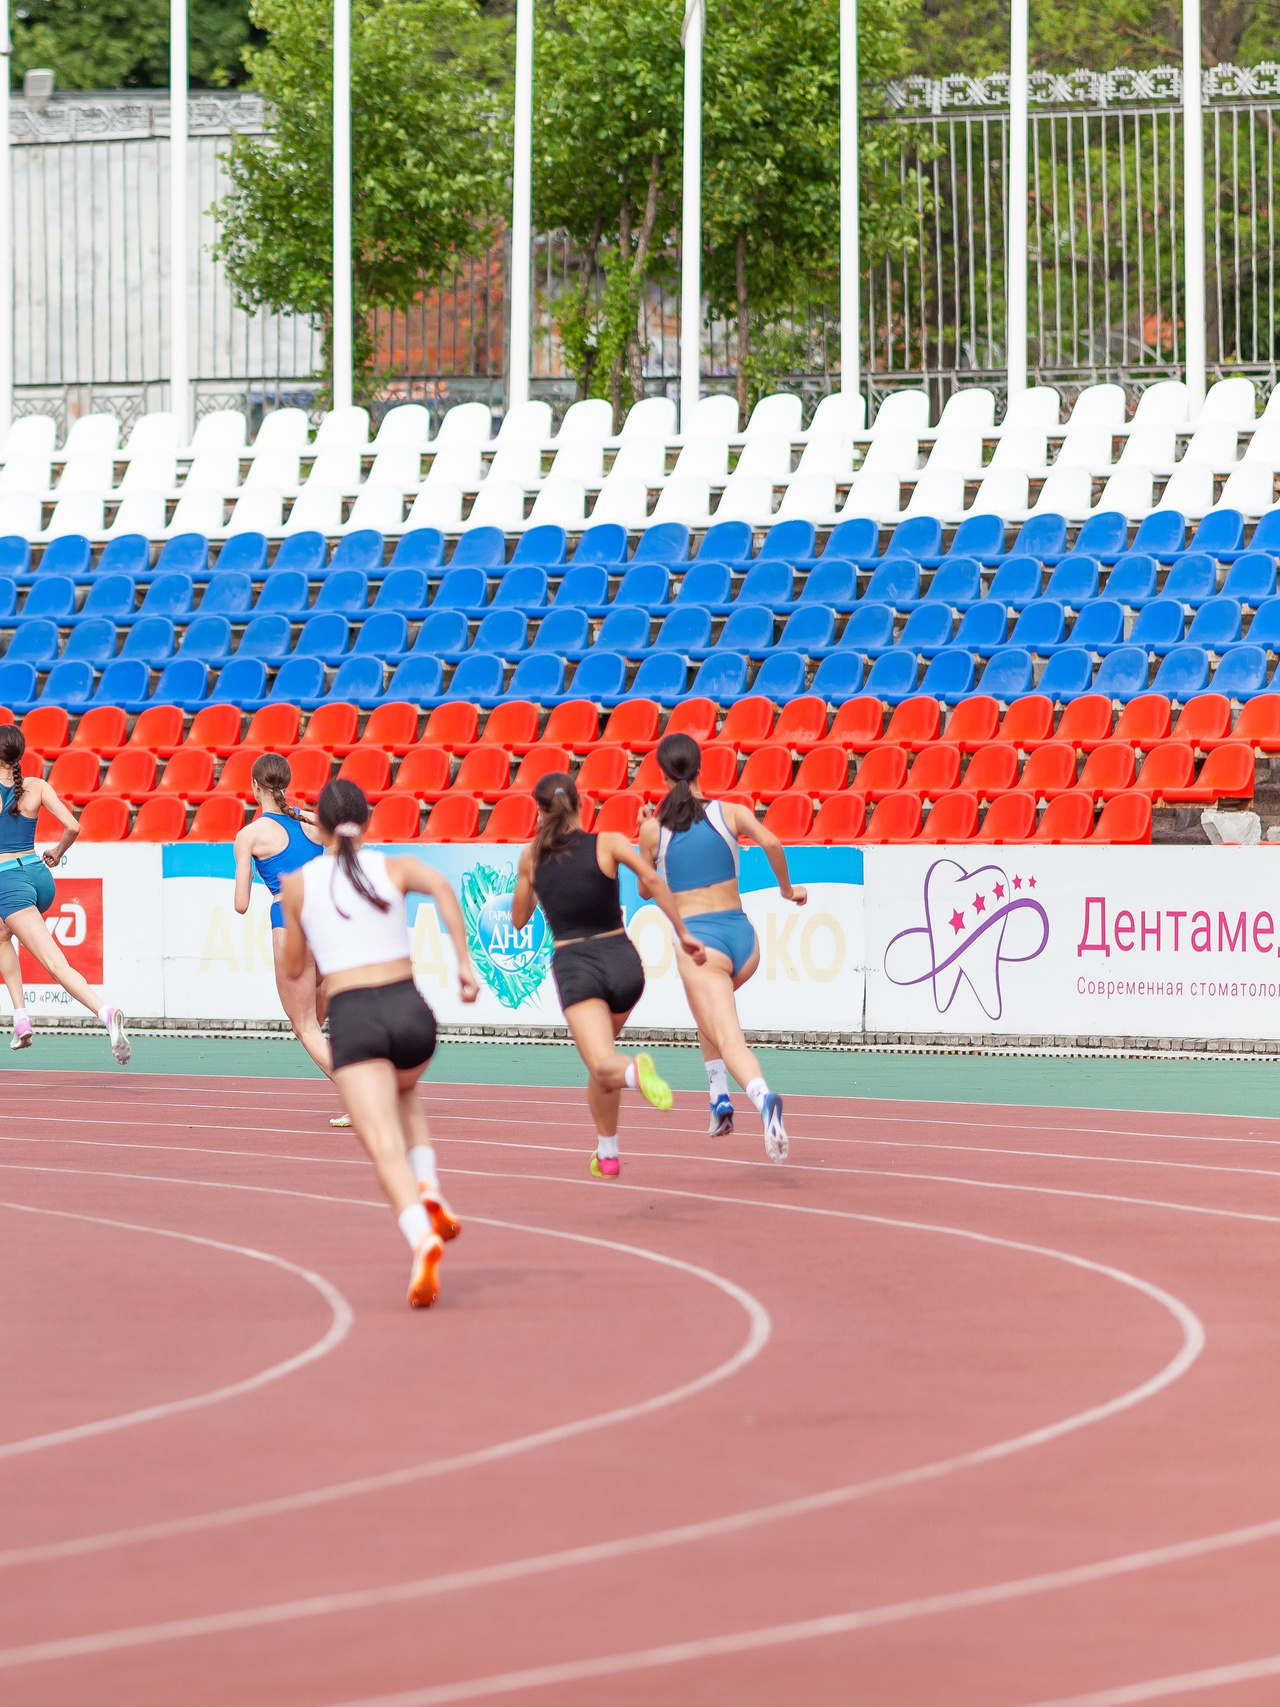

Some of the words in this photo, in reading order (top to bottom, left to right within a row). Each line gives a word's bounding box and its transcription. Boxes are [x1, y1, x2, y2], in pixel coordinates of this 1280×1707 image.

[488, 923, 534, 954] ДНЯ
[1077, 896, 1280, 957] Дентаме
[1076, 976, 1184, 999] Современная
